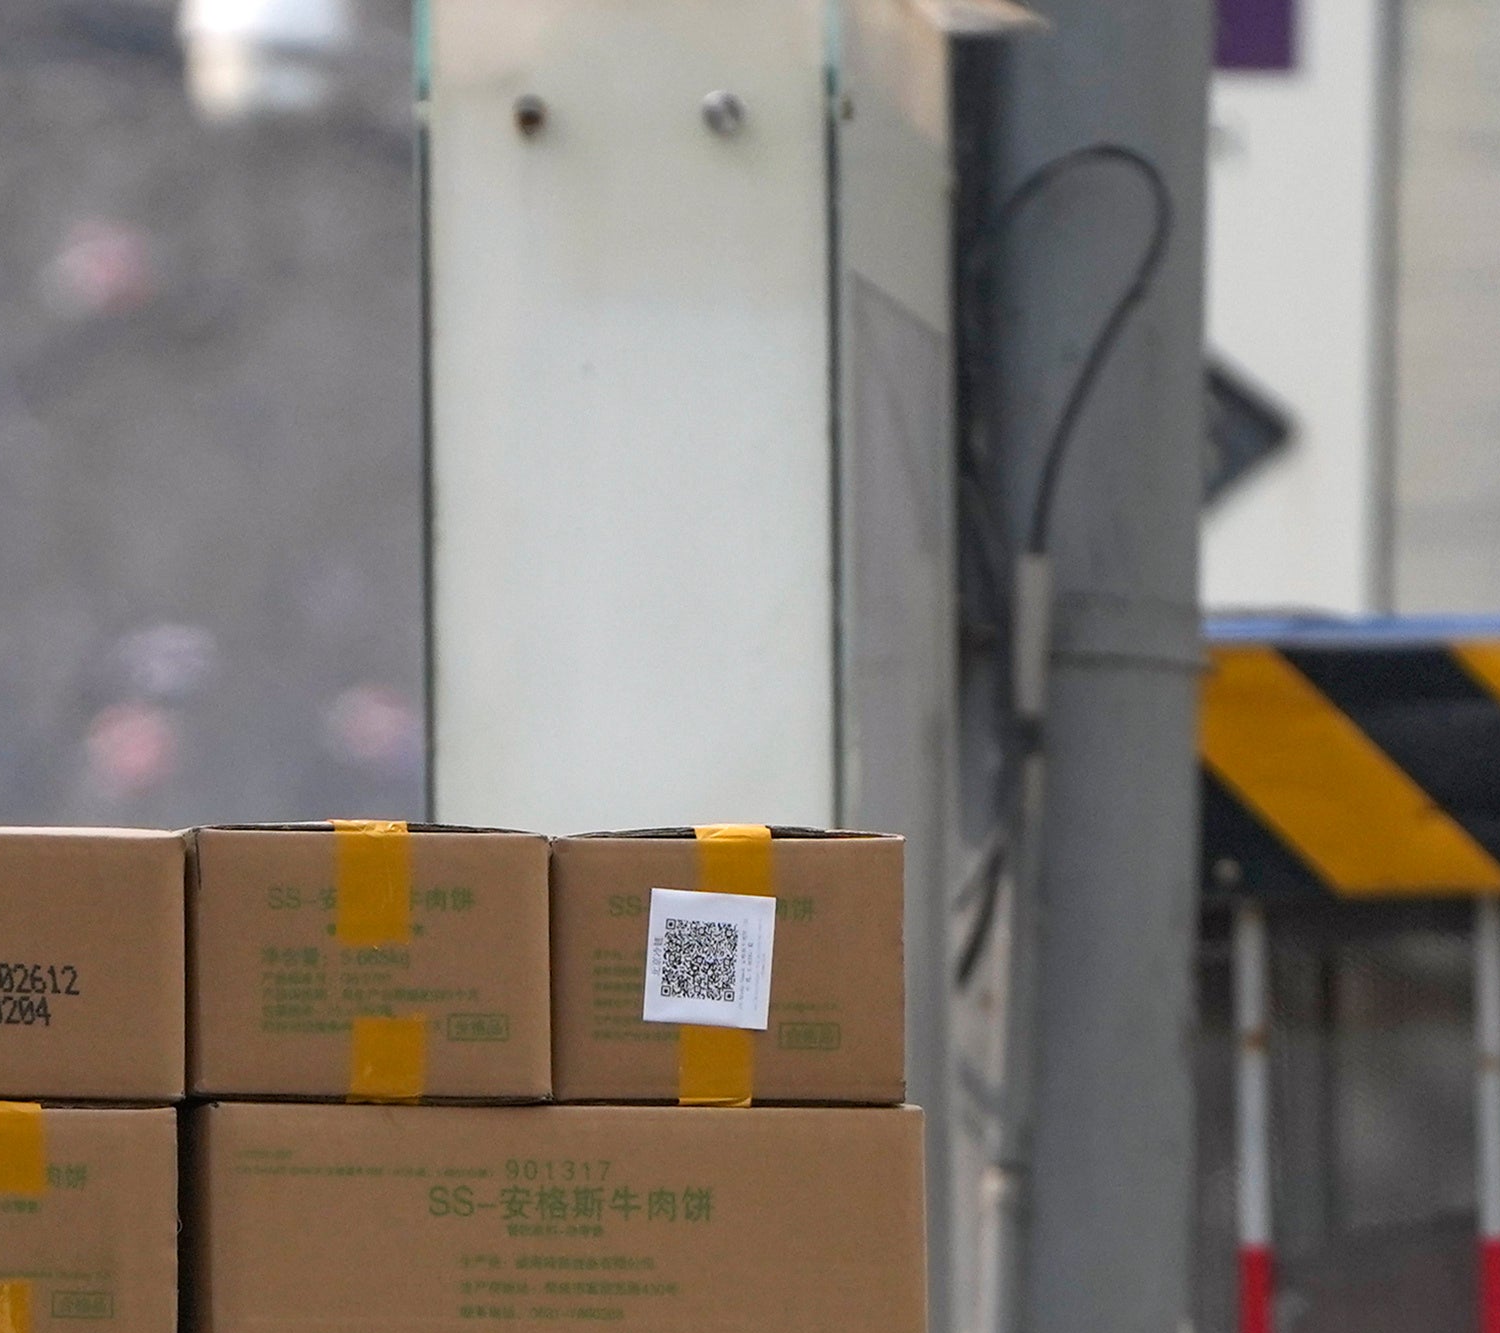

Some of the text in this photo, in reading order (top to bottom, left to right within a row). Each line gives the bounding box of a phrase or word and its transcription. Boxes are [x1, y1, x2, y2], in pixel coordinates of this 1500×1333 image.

[505, 1159, 613, 1182] 901317
[426, 1186, 717, 1224] SS-安格斯牛肉饼
